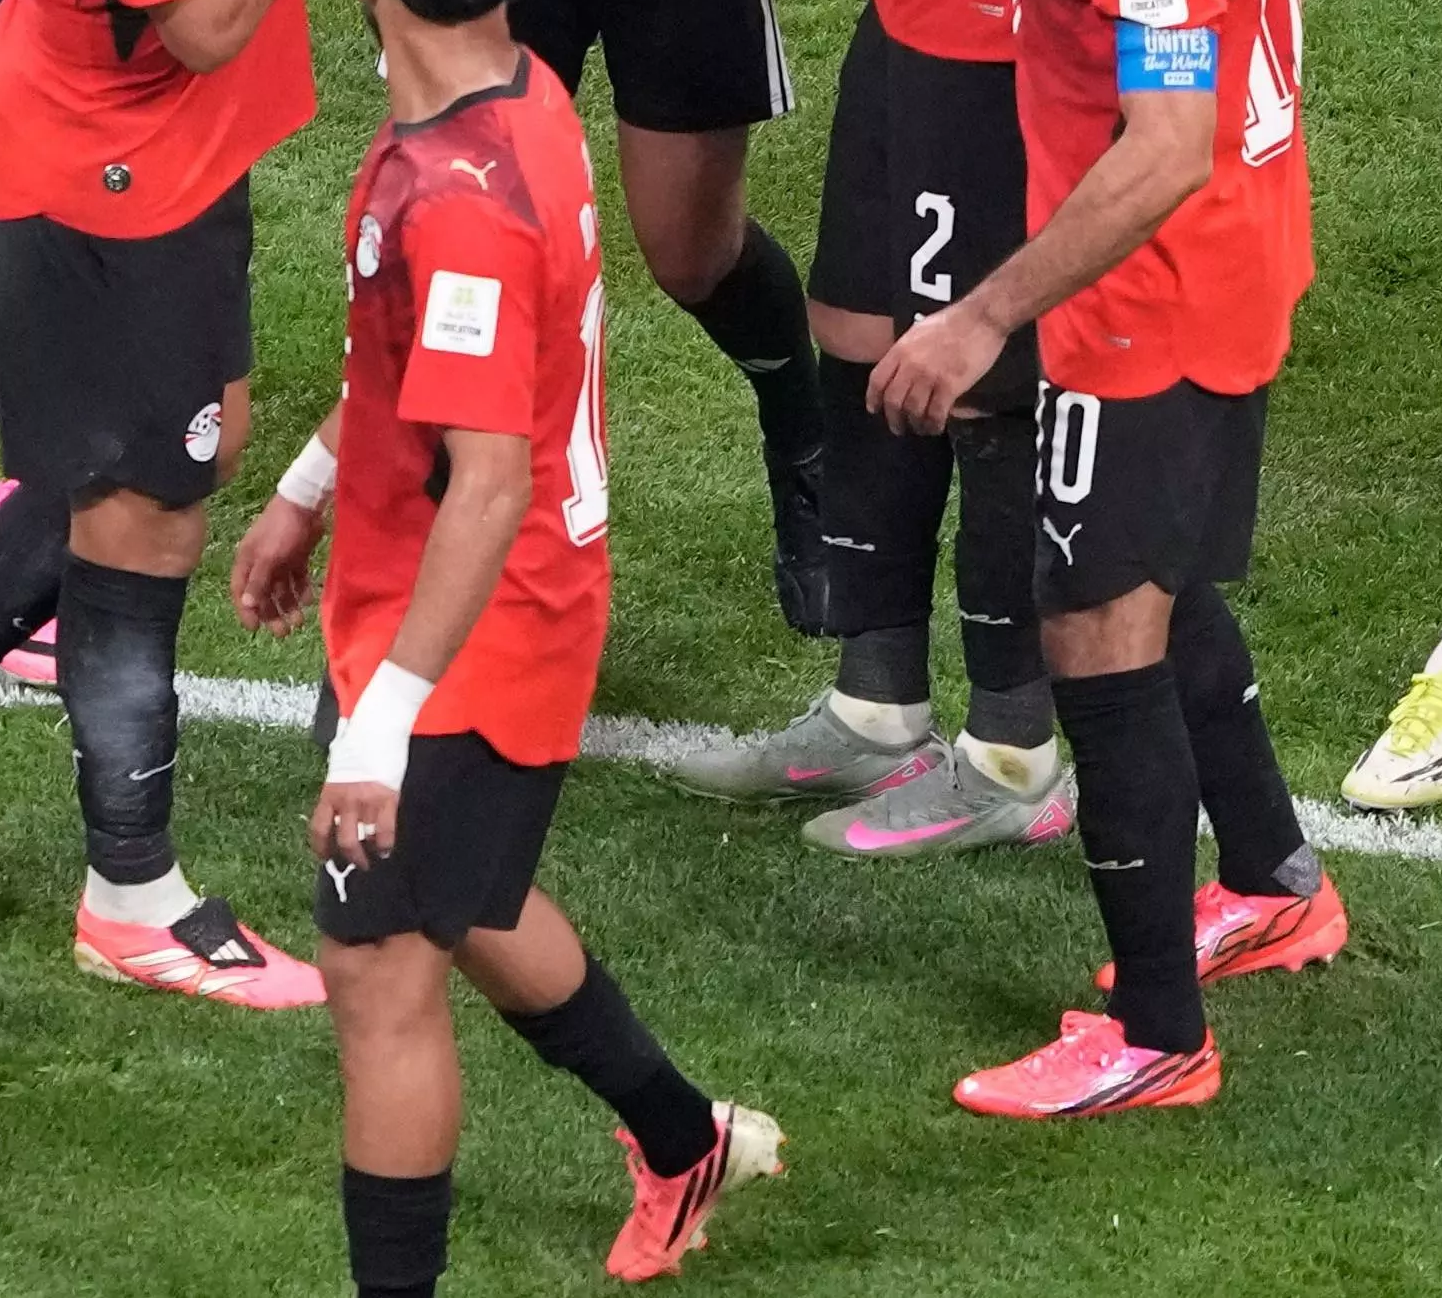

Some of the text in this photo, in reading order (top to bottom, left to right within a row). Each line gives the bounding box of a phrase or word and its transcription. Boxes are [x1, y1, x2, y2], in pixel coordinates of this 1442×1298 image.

[1144, 33, 1210, 54] UNITES
[1171, 53, 1213, 72] World
[910, 191, 955, 302] 2
